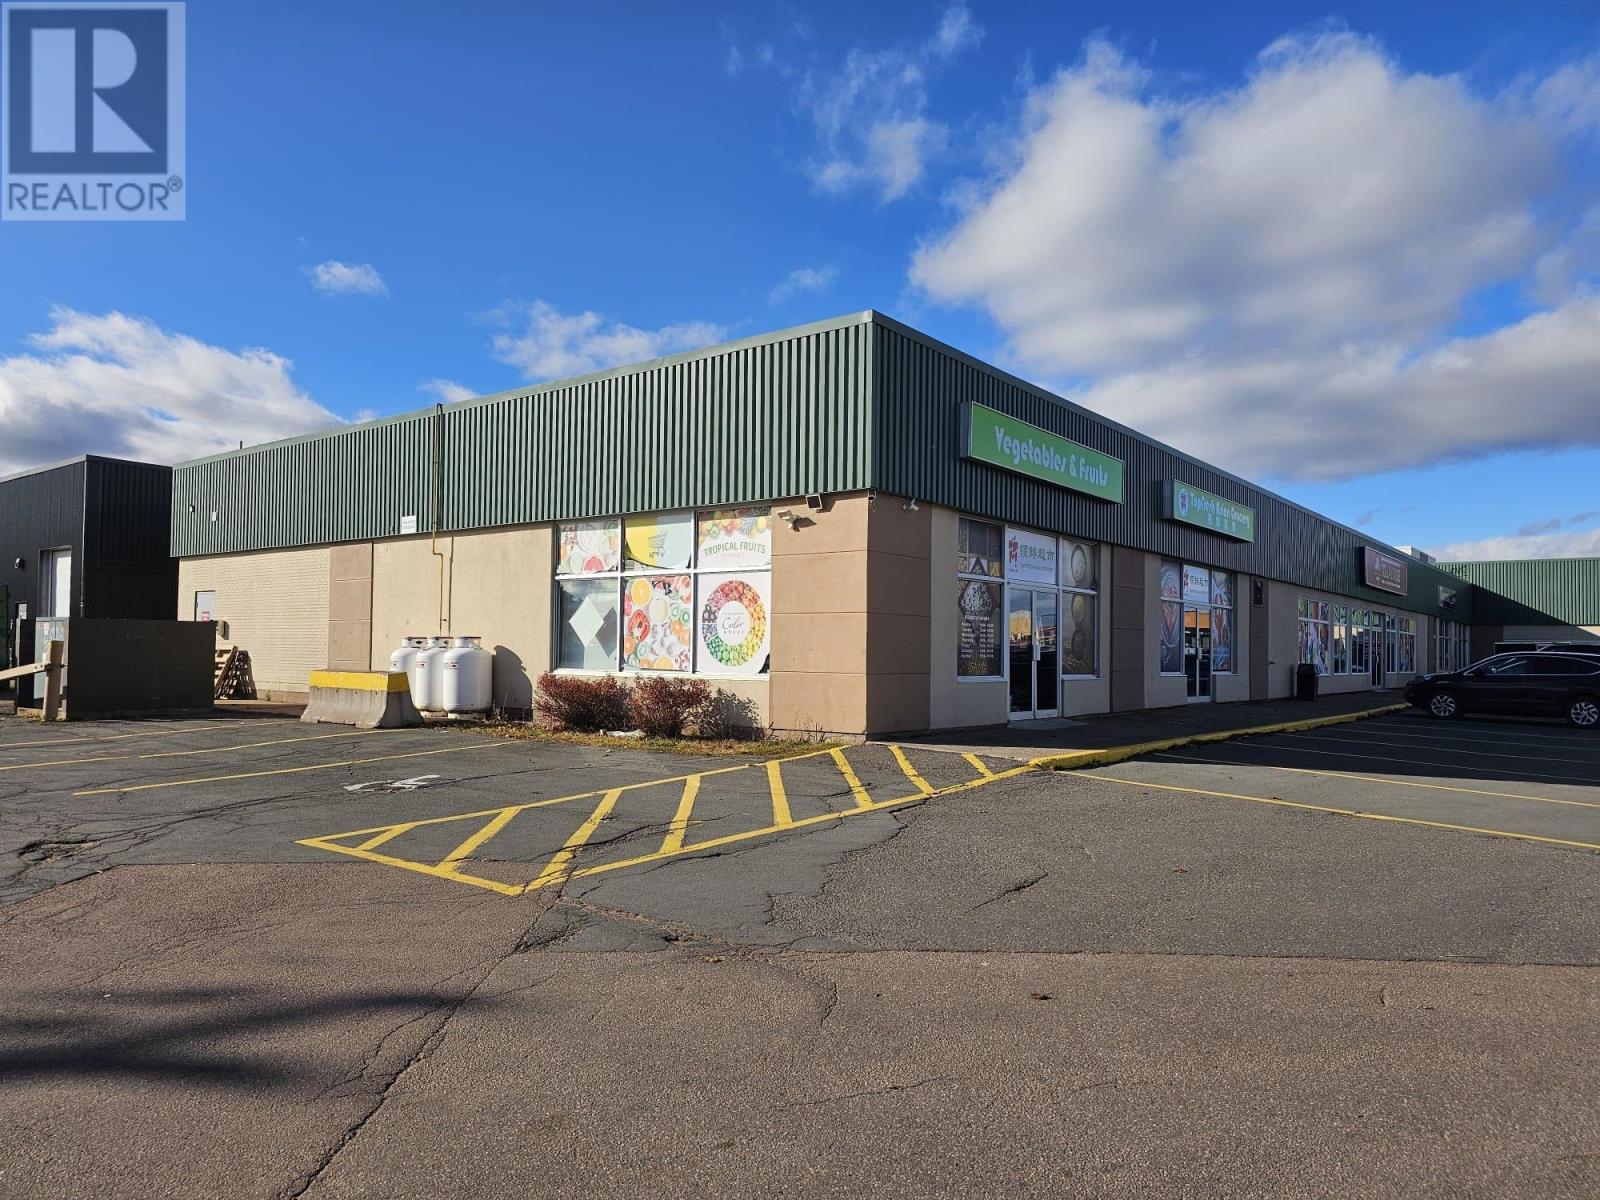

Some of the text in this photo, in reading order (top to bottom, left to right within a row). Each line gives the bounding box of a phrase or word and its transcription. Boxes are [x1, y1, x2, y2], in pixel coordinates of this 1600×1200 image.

[995, 425, 1108, 487] Vegetables & Fruits
[703, 541, 767, 558] TROPICAL FRUITS
